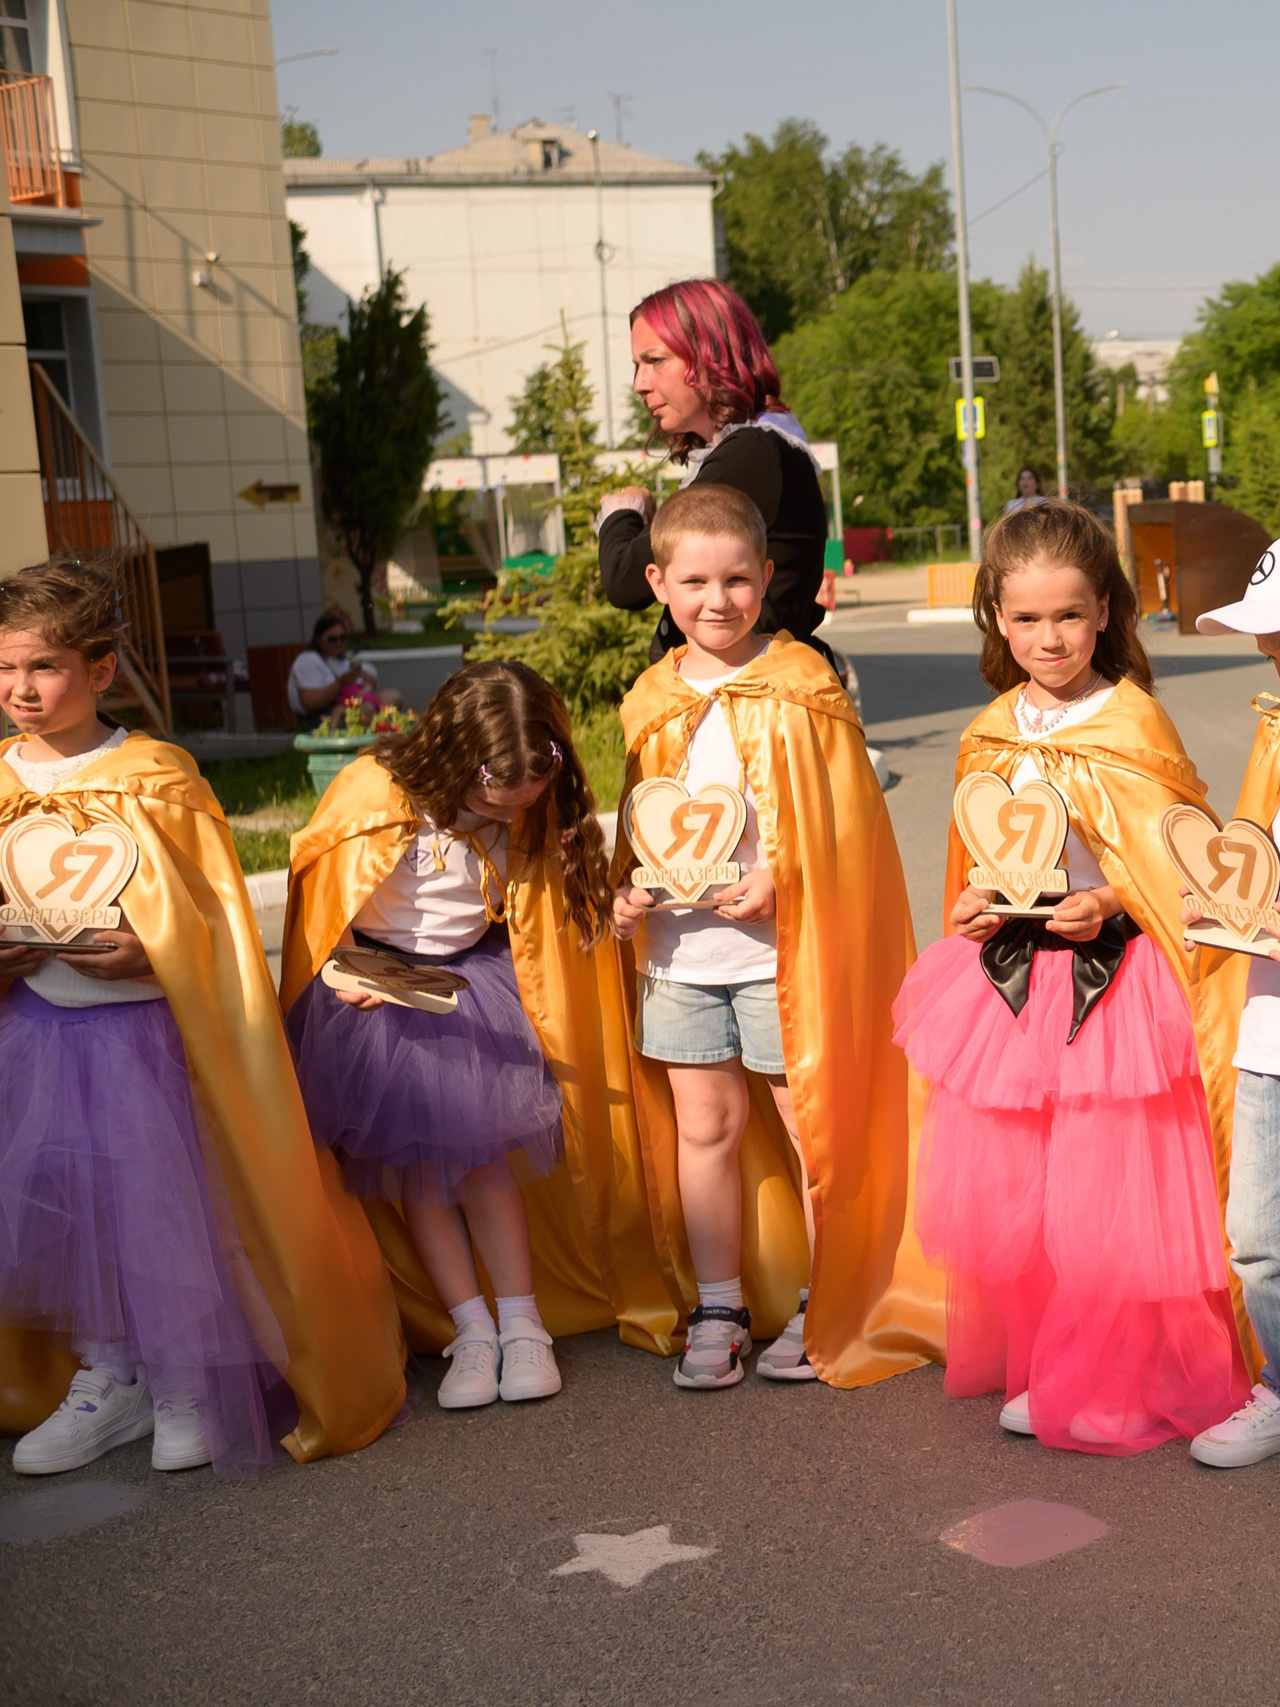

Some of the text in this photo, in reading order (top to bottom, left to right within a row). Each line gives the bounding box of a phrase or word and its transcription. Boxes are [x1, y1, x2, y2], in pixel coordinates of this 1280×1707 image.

[634, 864, 738, 885] ФАНТАЗЁРЫ
[970, 868, 1065, 890] ФАНТАЗЁРЫ
[0, 907, 119, 926] ФАНТАЗЁРЫ
